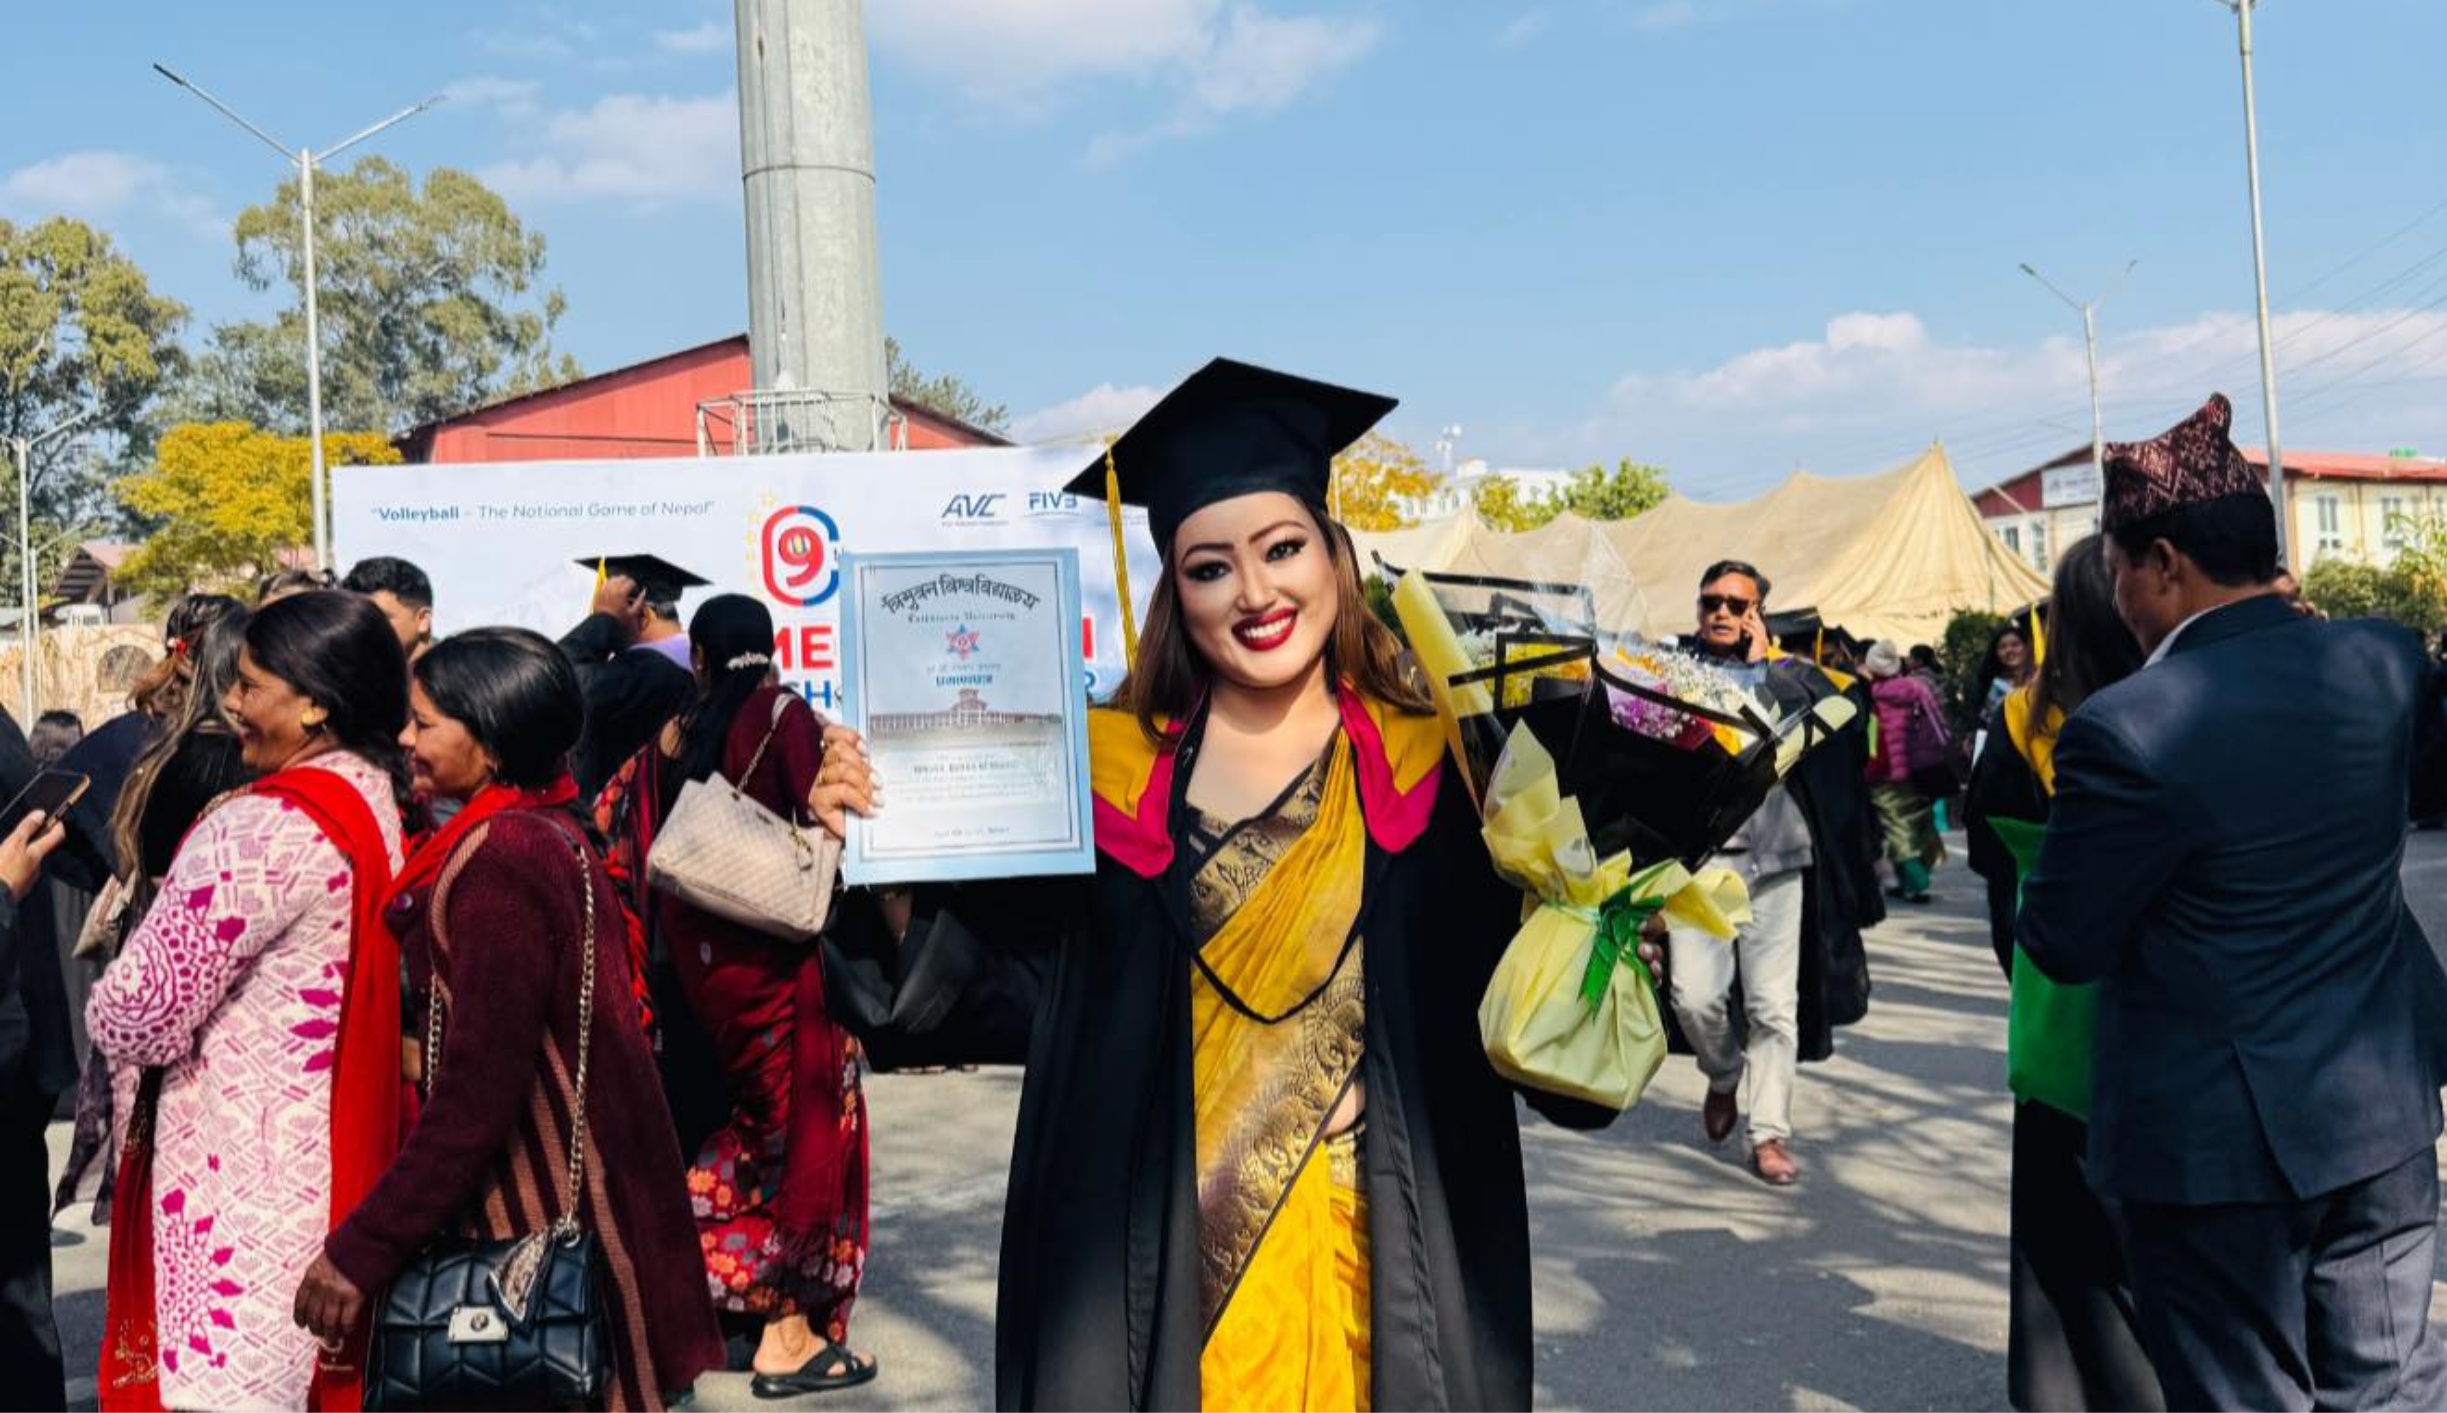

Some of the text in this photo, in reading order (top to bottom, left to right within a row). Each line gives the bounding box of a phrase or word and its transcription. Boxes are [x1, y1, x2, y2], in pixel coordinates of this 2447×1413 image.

[478, 504, 508, 519] The
[513, 502, 583, 518] National
[588, 501, 637, 517] Game
[641, 501, 657, 516] of
[942, 493, 1006, 518] AVC
[778, 526, 824, 588] 9
